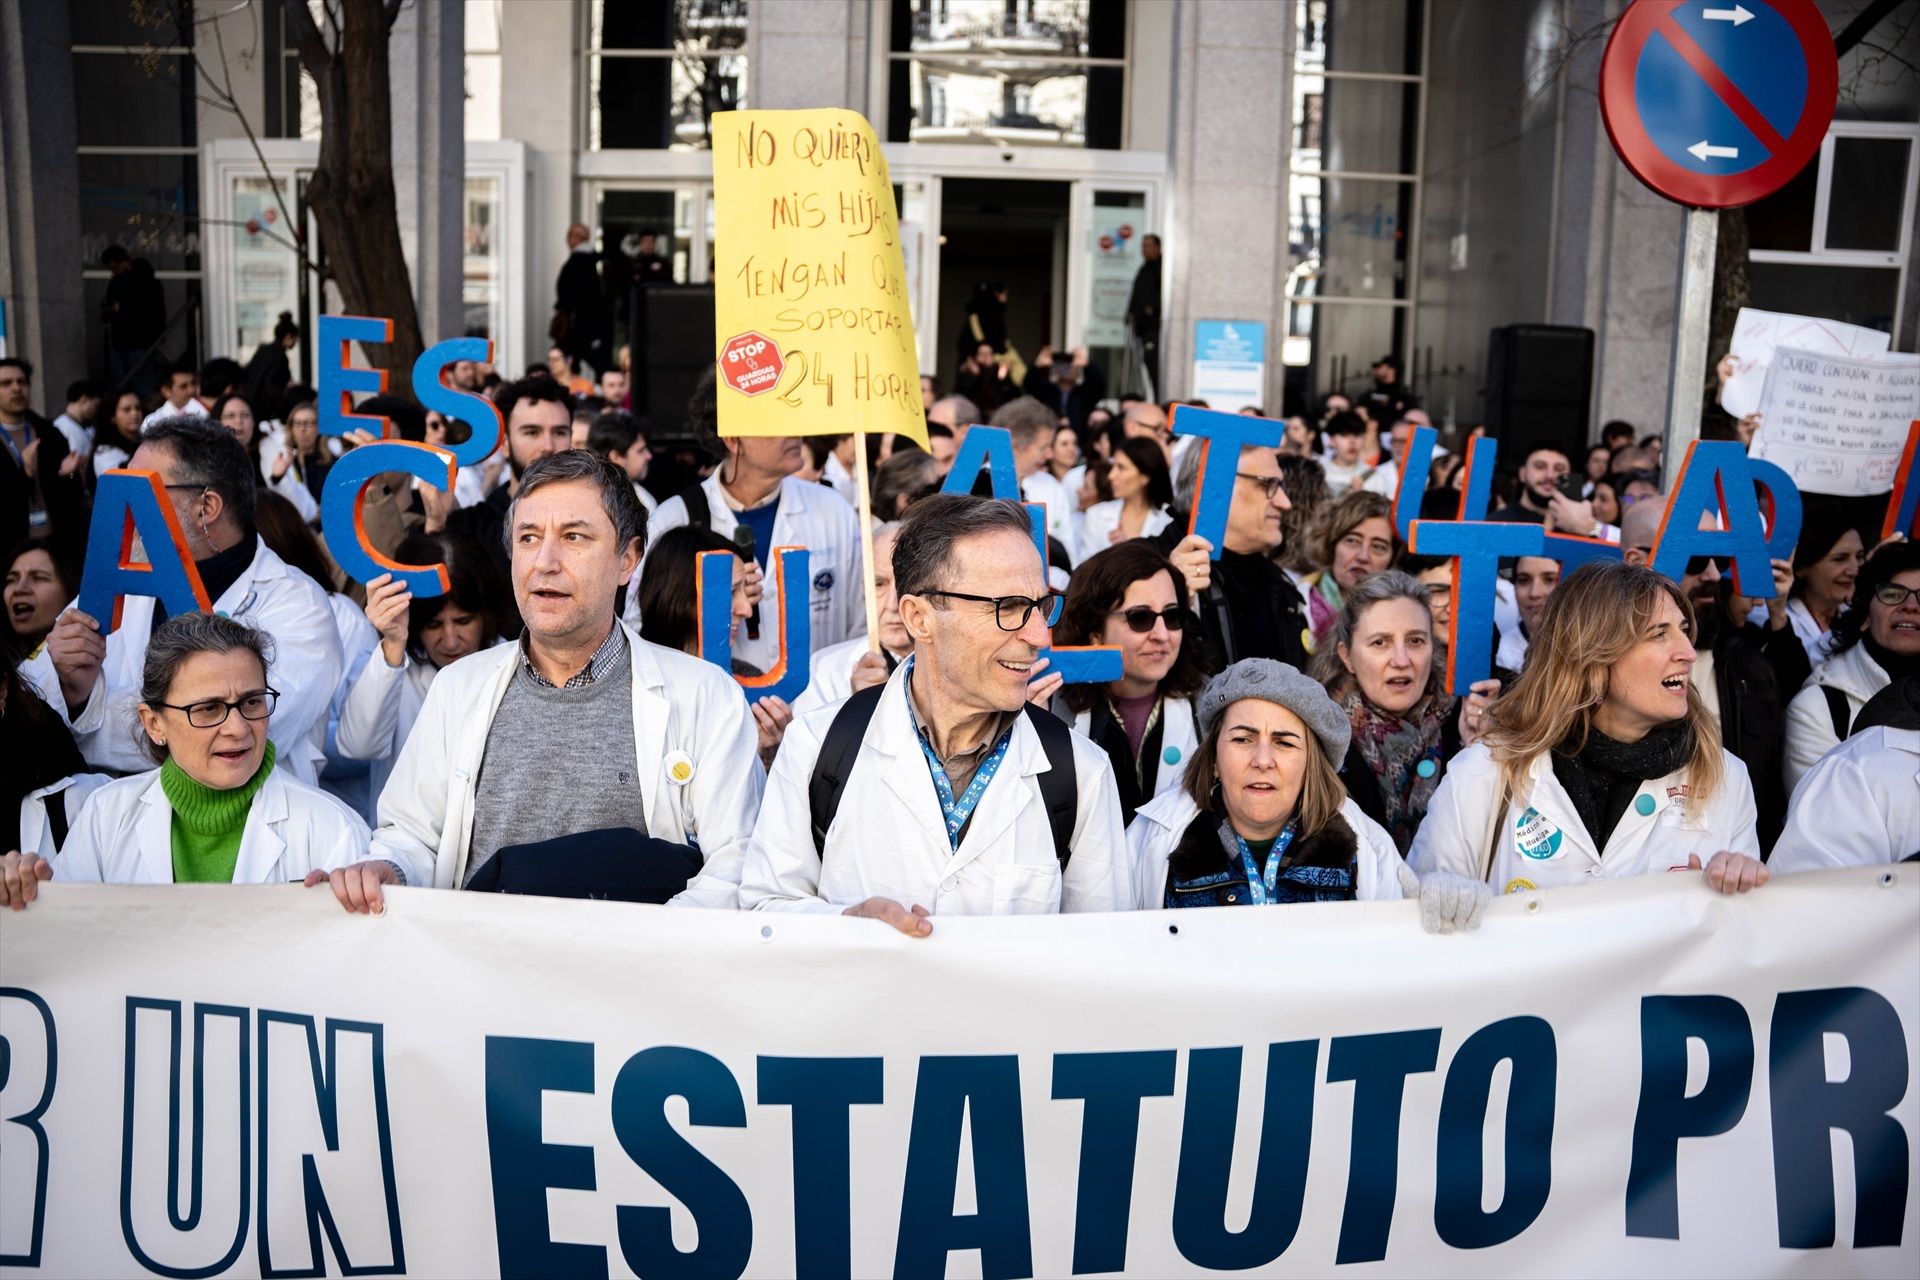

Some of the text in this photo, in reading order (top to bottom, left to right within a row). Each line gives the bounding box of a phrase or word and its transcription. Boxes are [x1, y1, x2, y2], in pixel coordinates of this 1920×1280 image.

[738, 121, 776, 168] NO
[771, 308, 907, 352] SOPORTAR
[727, 341, 767, 363] STOP
[736, 365, 776, 384] GUARDIAS
[750, 372, 777, 387] HORAS
[777, 350, 833, 407] 24
[1516, 821, 1541, 839] Médico
[1525, 828, 1550, 848] Huelga
[120, 996, 406, 1280] UN
[485, 1015, 1557, 1280] ESTATUTO
[1625, 986, 1909, 1250] PR
